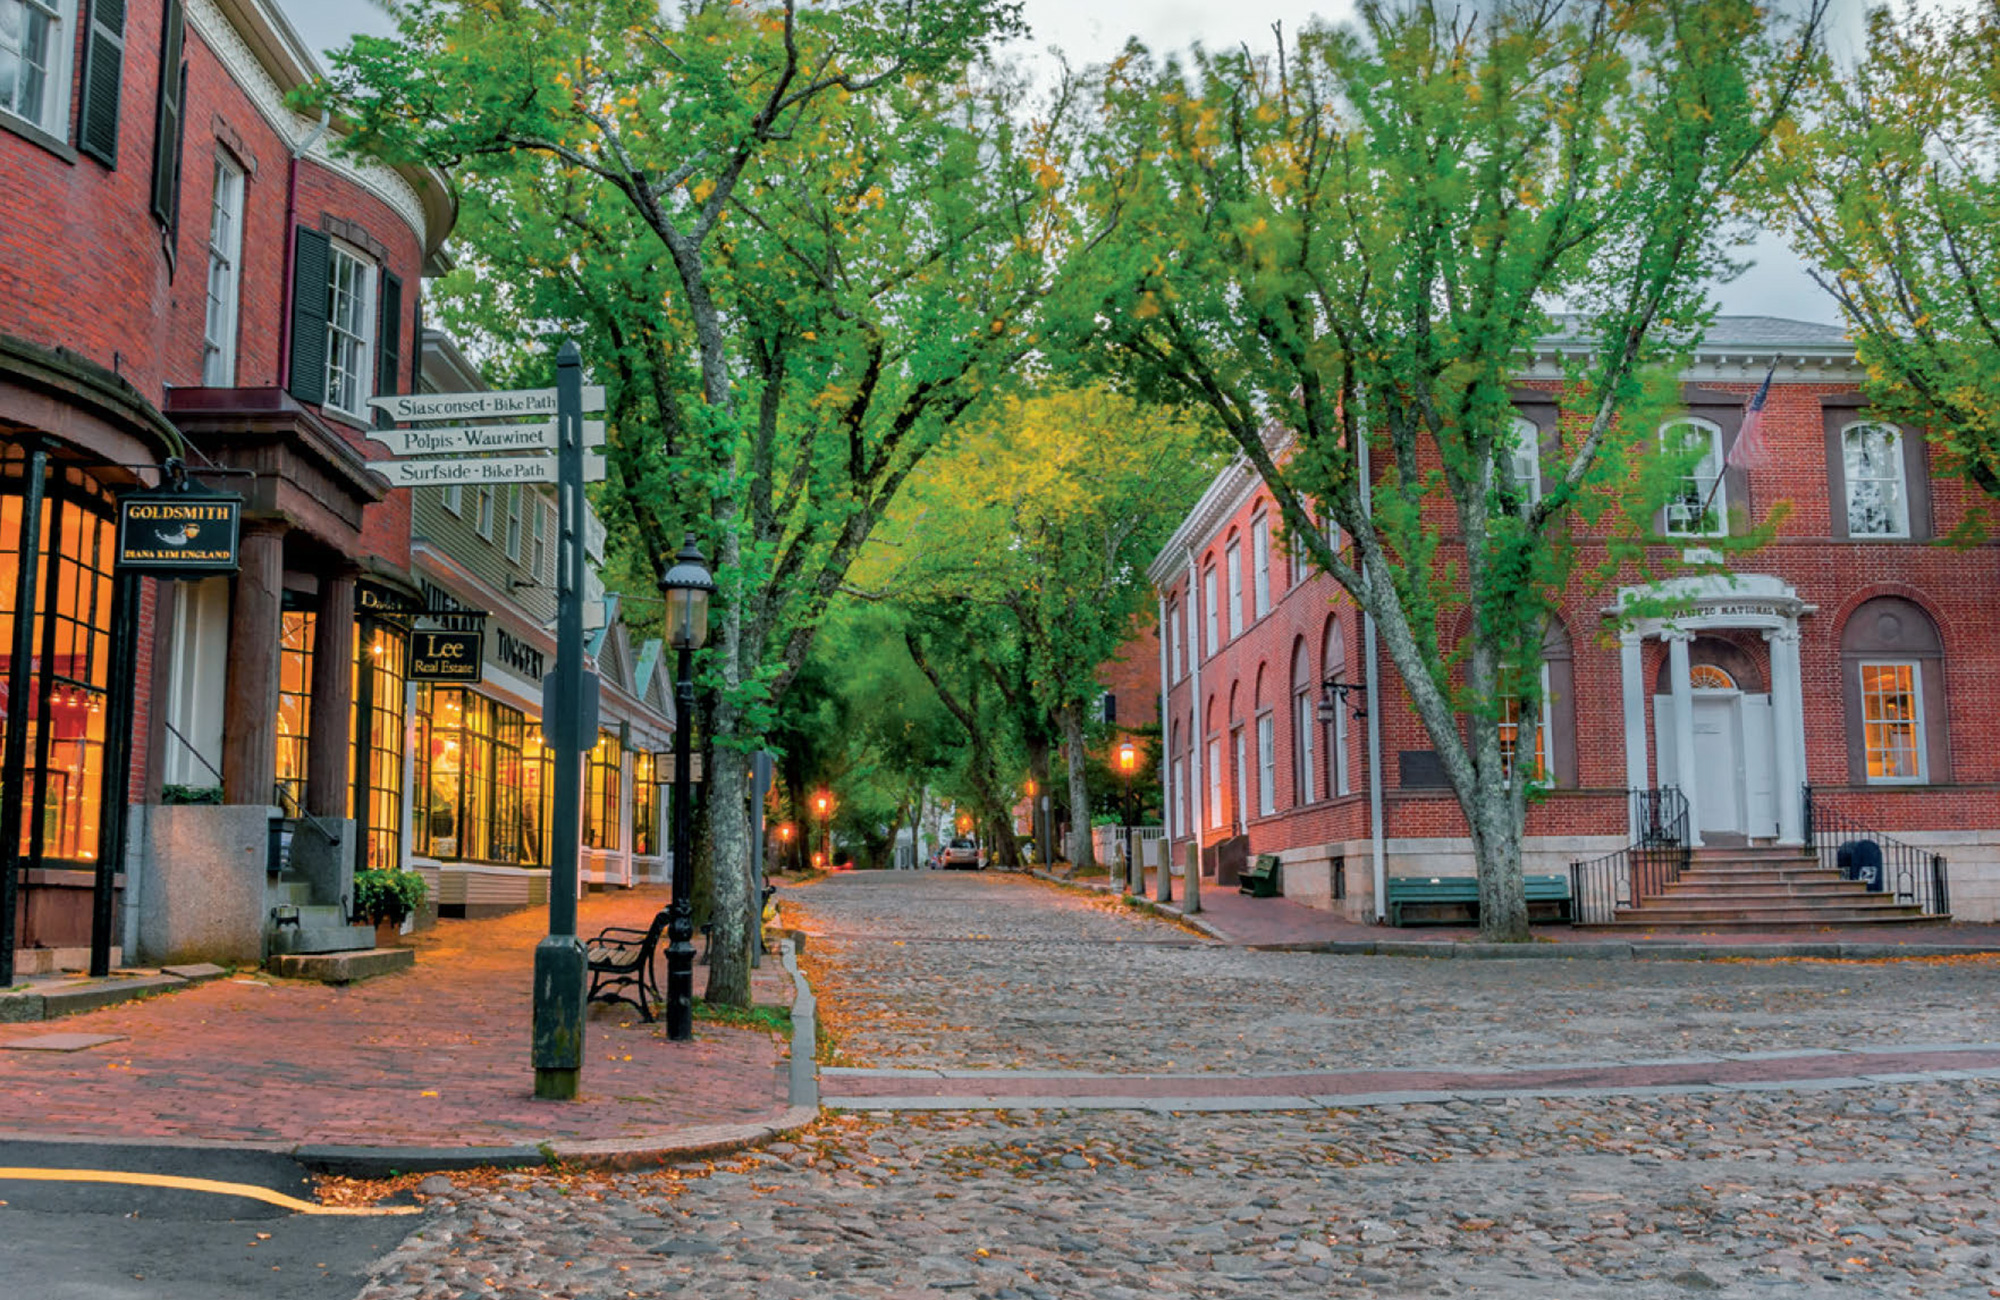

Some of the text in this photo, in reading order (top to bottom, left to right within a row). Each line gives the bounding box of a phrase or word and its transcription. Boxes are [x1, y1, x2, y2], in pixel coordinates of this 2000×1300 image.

[398, 398, 485, 416] Siasconset
[494, 397, 524, 412] Bike
[526, 395, 556, 409] Path
[404, 432, 454, 451] Polpis
[464, 429, 543, 447] Wauwinet
[401, 464, 471, 480] Surfside
[482, 465, 513, 478] Bike
[515, 463, 545, 477] Path
[129, 506, 229, 520] GOLDSMITH
[181, 549, 230, 559] ENGLAND
[427, 635, 464, 658] Lee
[497, 627, 544, 683] TOGGERY
[415, 660, 474, 673] Real Estate
